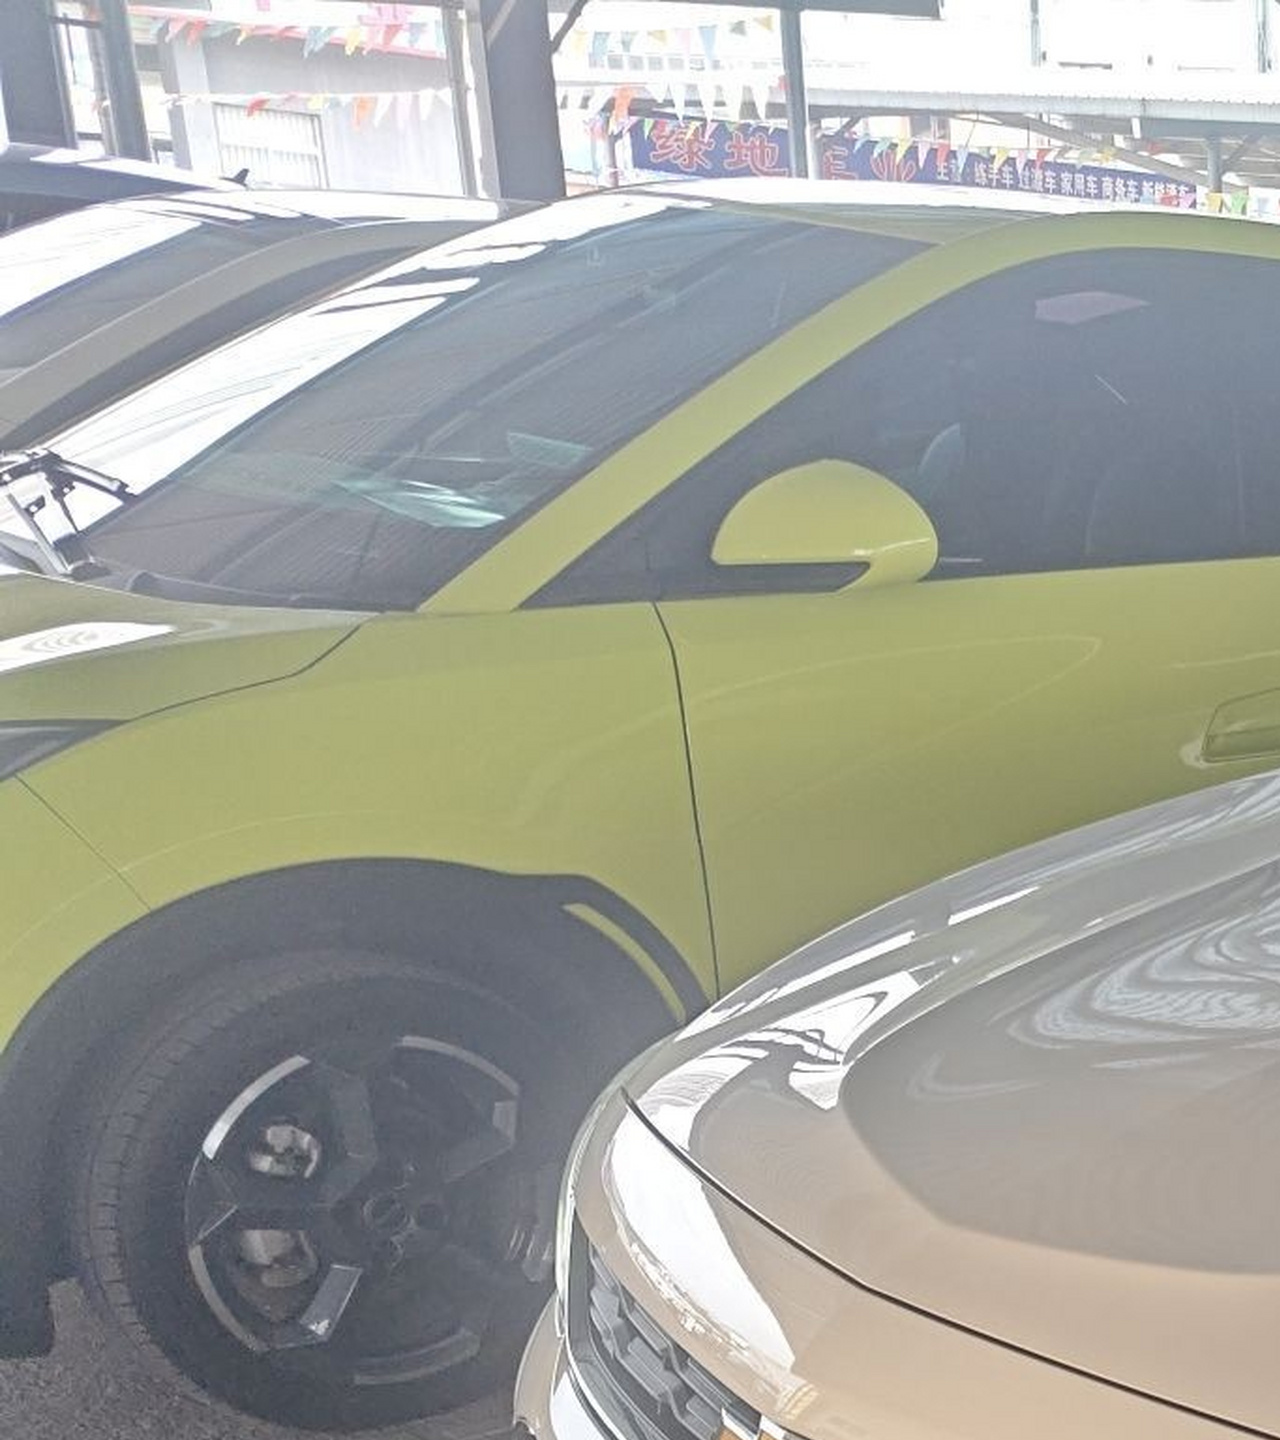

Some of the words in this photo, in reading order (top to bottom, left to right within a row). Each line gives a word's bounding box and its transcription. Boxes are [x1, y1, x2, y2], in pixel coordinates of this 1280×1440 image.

[1060, 171, 1099, 198] 家用车
[1101, 175, 1140, 203] 商务车
